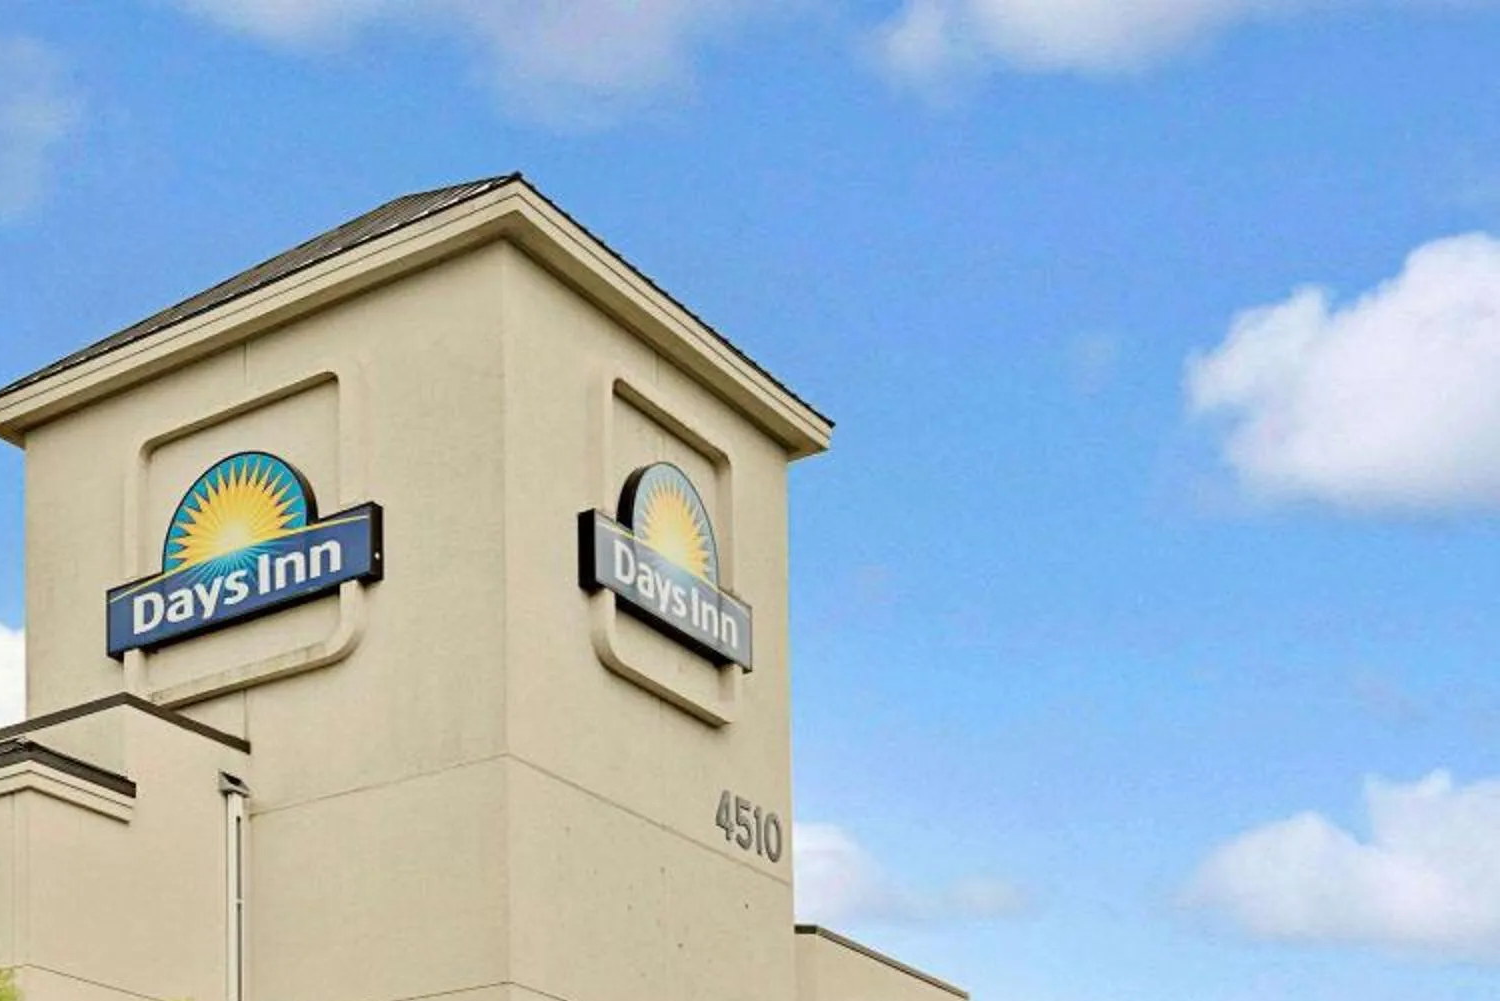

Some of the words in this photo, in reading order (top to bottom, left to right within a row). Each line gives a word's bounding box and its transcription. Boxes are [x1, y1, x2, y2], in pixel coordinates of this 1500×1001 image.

[132, 568, 249, 635] Days
[257, 539, 342, 595] Inn
[613, 539, 687, 621] Days
[690, 588, 739, 650] Inn
[715, 788, 783, 864] 4510
